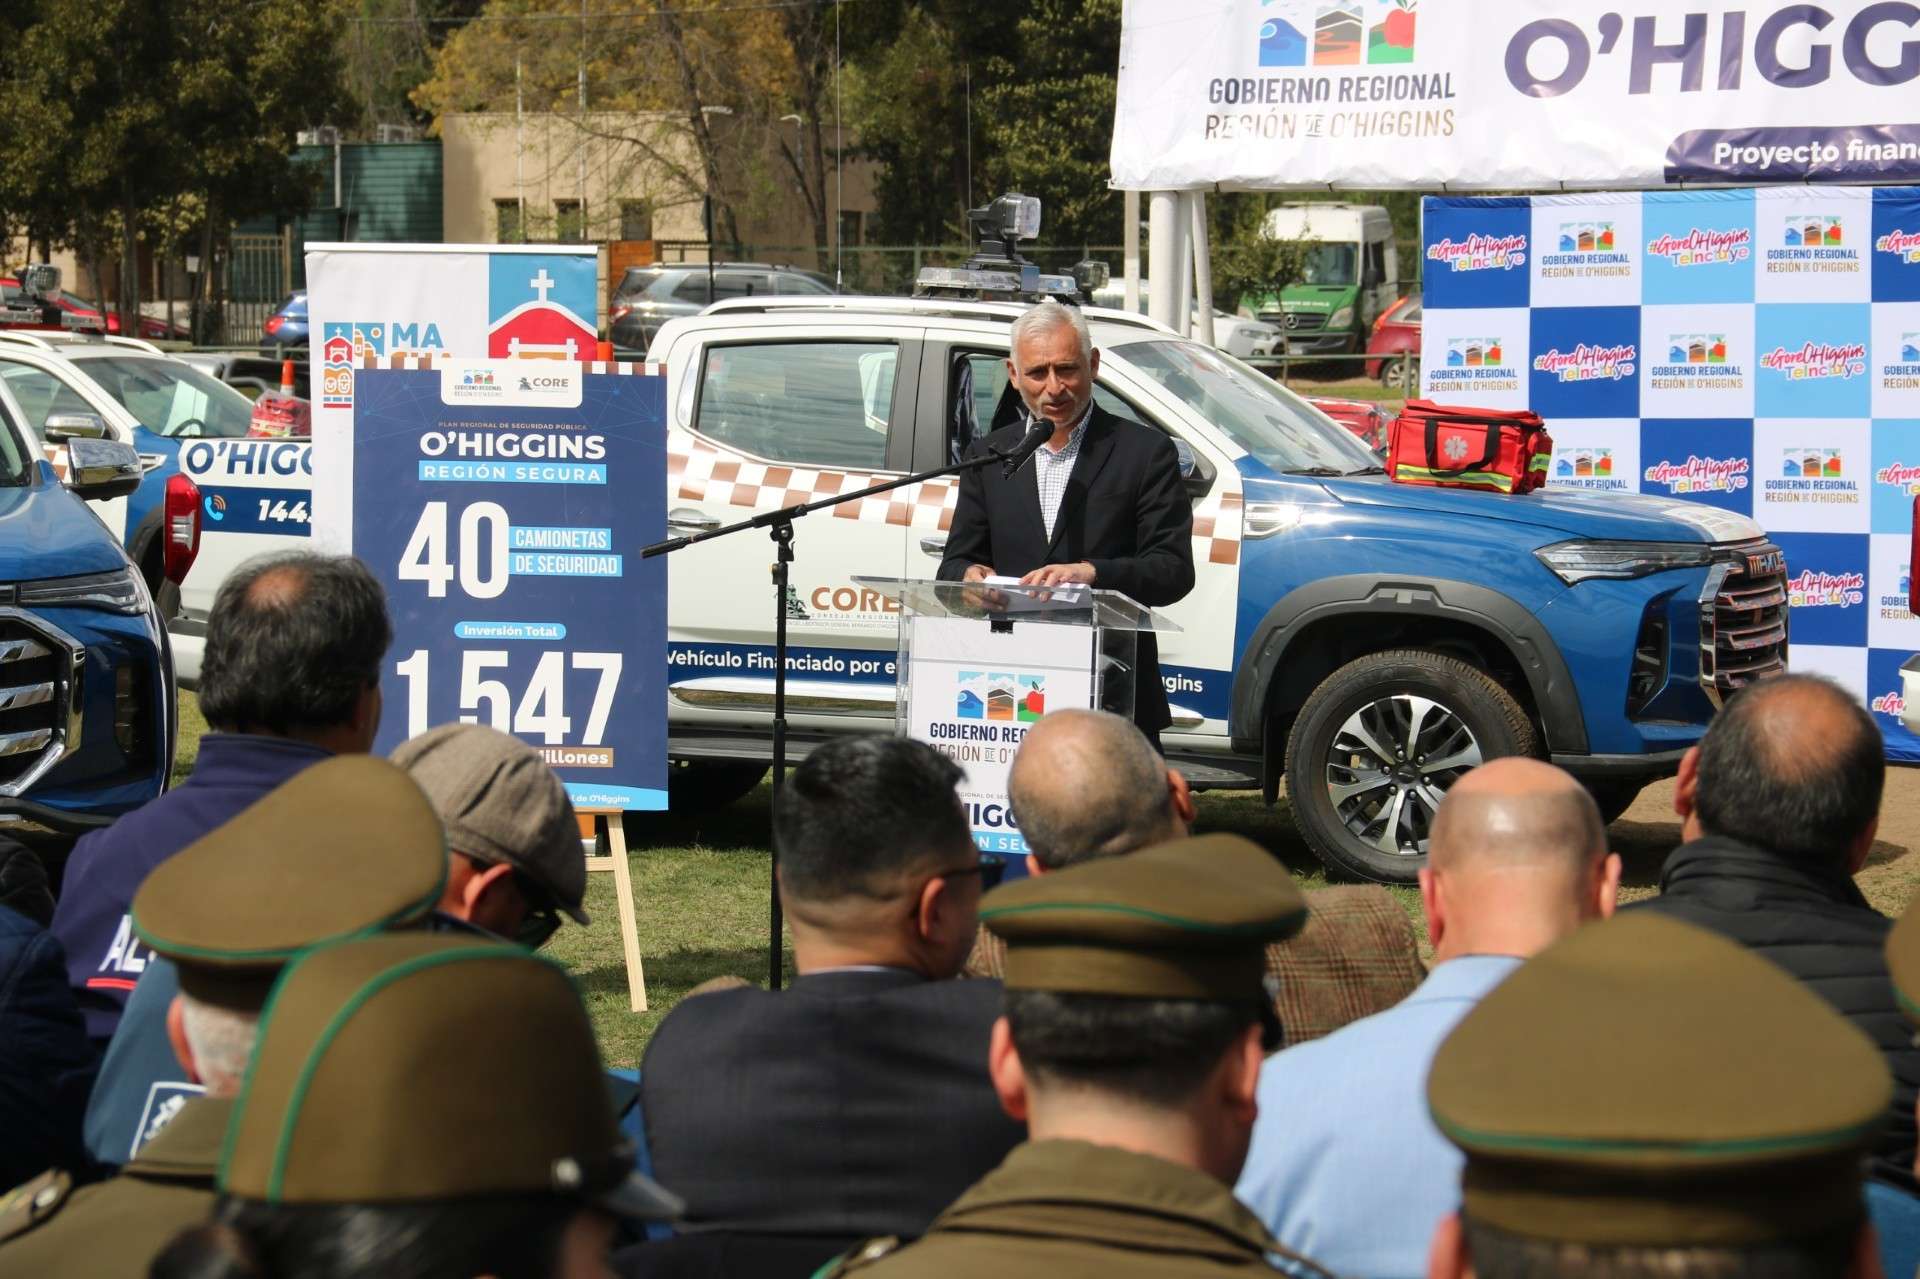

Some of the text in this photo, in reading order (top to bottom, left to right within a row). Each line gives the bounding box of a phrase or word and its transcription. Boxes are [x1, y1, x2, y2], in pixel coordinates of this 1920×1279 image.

[1209, 72, 1456, 104] GOBIERNO REGIONAL
[1205, 107, 1297, 139] REGIÓN
[1714, 140, 1840, 169] Proyecto
[1542, 253, 1630, 265] GOBIERNO REGIONAL
[1767, 249, 1859, 260] GOBIERNO REGIONAL
[392, 322, 444, 348] MA
[1430, 368, 1518, 380] GOBIERNO REGIONAL
[1652, 366, 1742, 376] GOBIERNO REGIONAL
[533, 378, 568, 388] CORE
[424, 463, 601, 482] REGIÓN SEGURA
[1765, 479, 1858, 491] GOBIERNO REGIONAL
[258, 499, 312, 523] 144
[515, 529, 607, 548] CAMIONETAS
[398, 501, 510, 599] 40
[515, 555, 618, 575] DE SEGURIDAD
[1788, 572, 1863, 593] reOHiggins
[811, 587, 900, 613] CORE
[463, 624, 558, 637] Inversión Total
[668, 651, 742, 667] Vehículo
[747, 653, 844, 672] Finnciado
[850, 658, 880, 676] por
[1161, 673, 1203, 693] gins
[930, 722, 997, 741] GOBIERNO
[538, 749, 609, 764] illones
[984, 747, 996, 762] DE
[999, 748, 1015, 764] O'
[98, 914, 156, 973] AL
